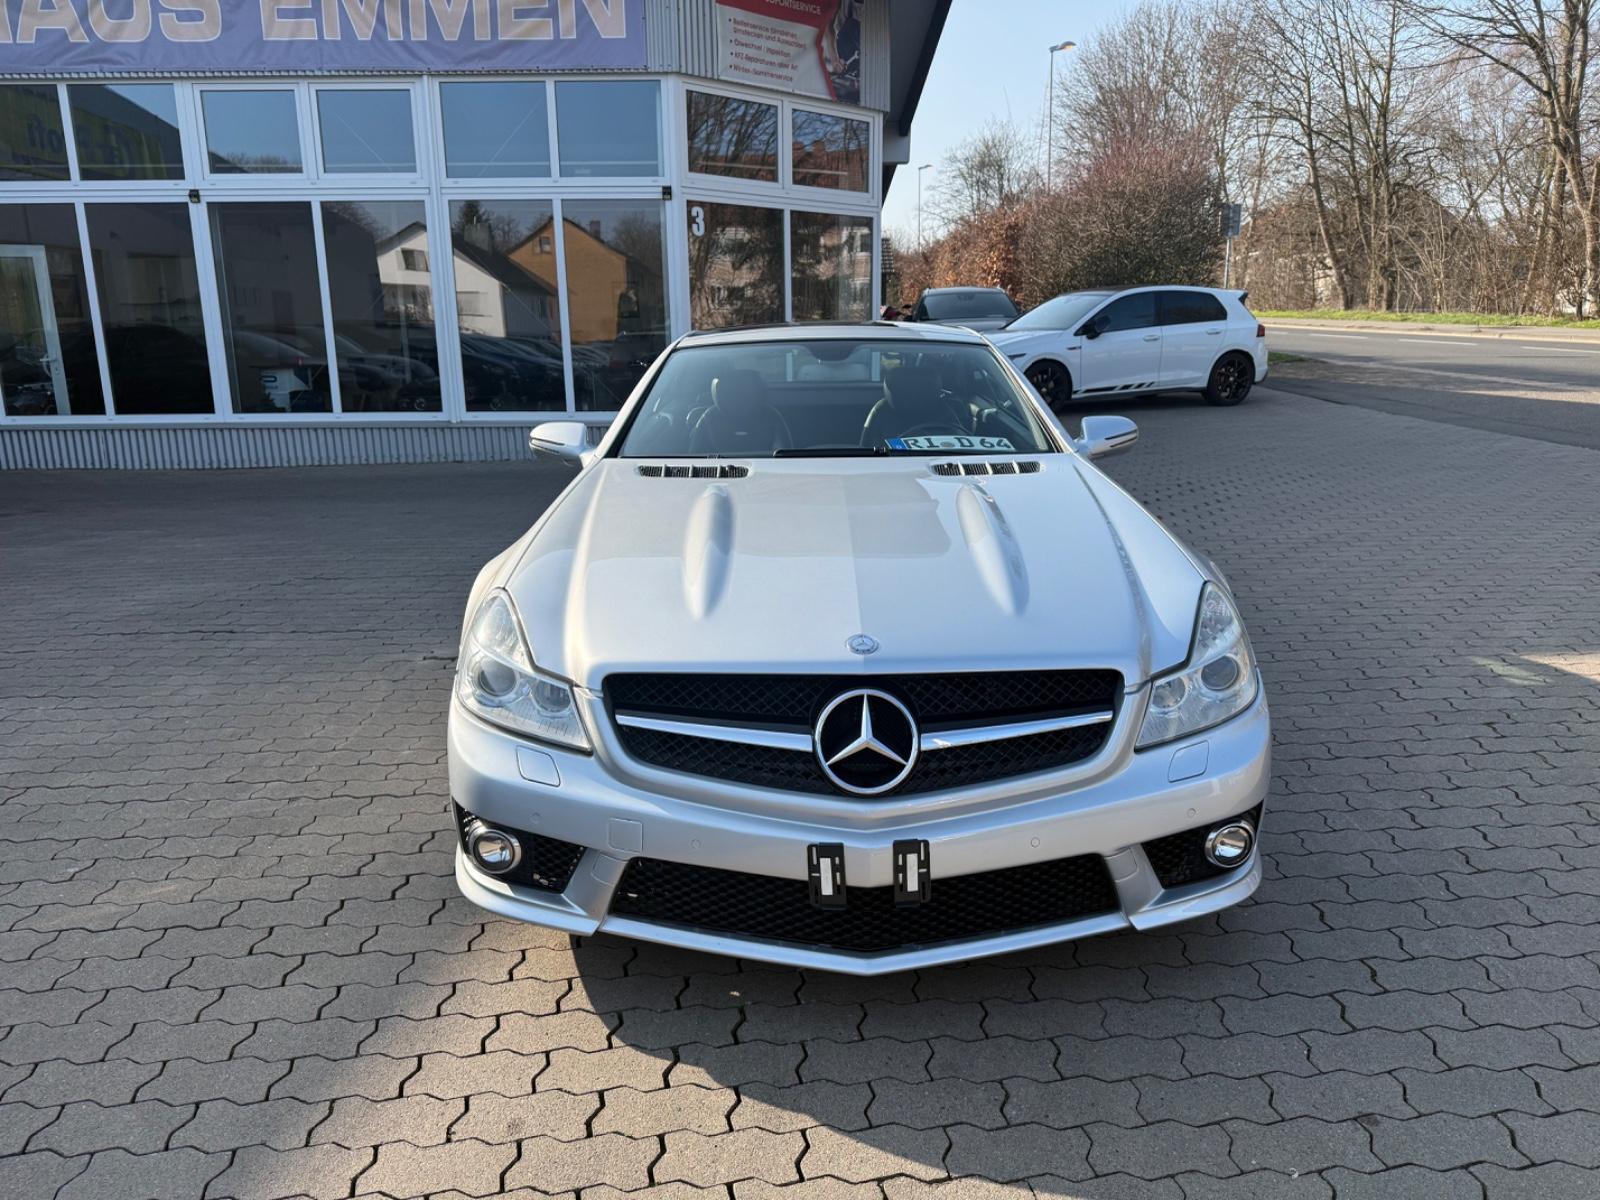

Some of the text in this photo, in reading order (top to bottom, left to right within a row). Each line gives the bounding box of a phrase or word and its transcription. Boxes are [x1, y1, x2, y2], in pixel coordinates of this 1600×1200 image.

[0, 0, 627, 43] AUS EMMEN
[691, 206, 705, 237] 3
[903, 437, 1011, 449] RI D 64
